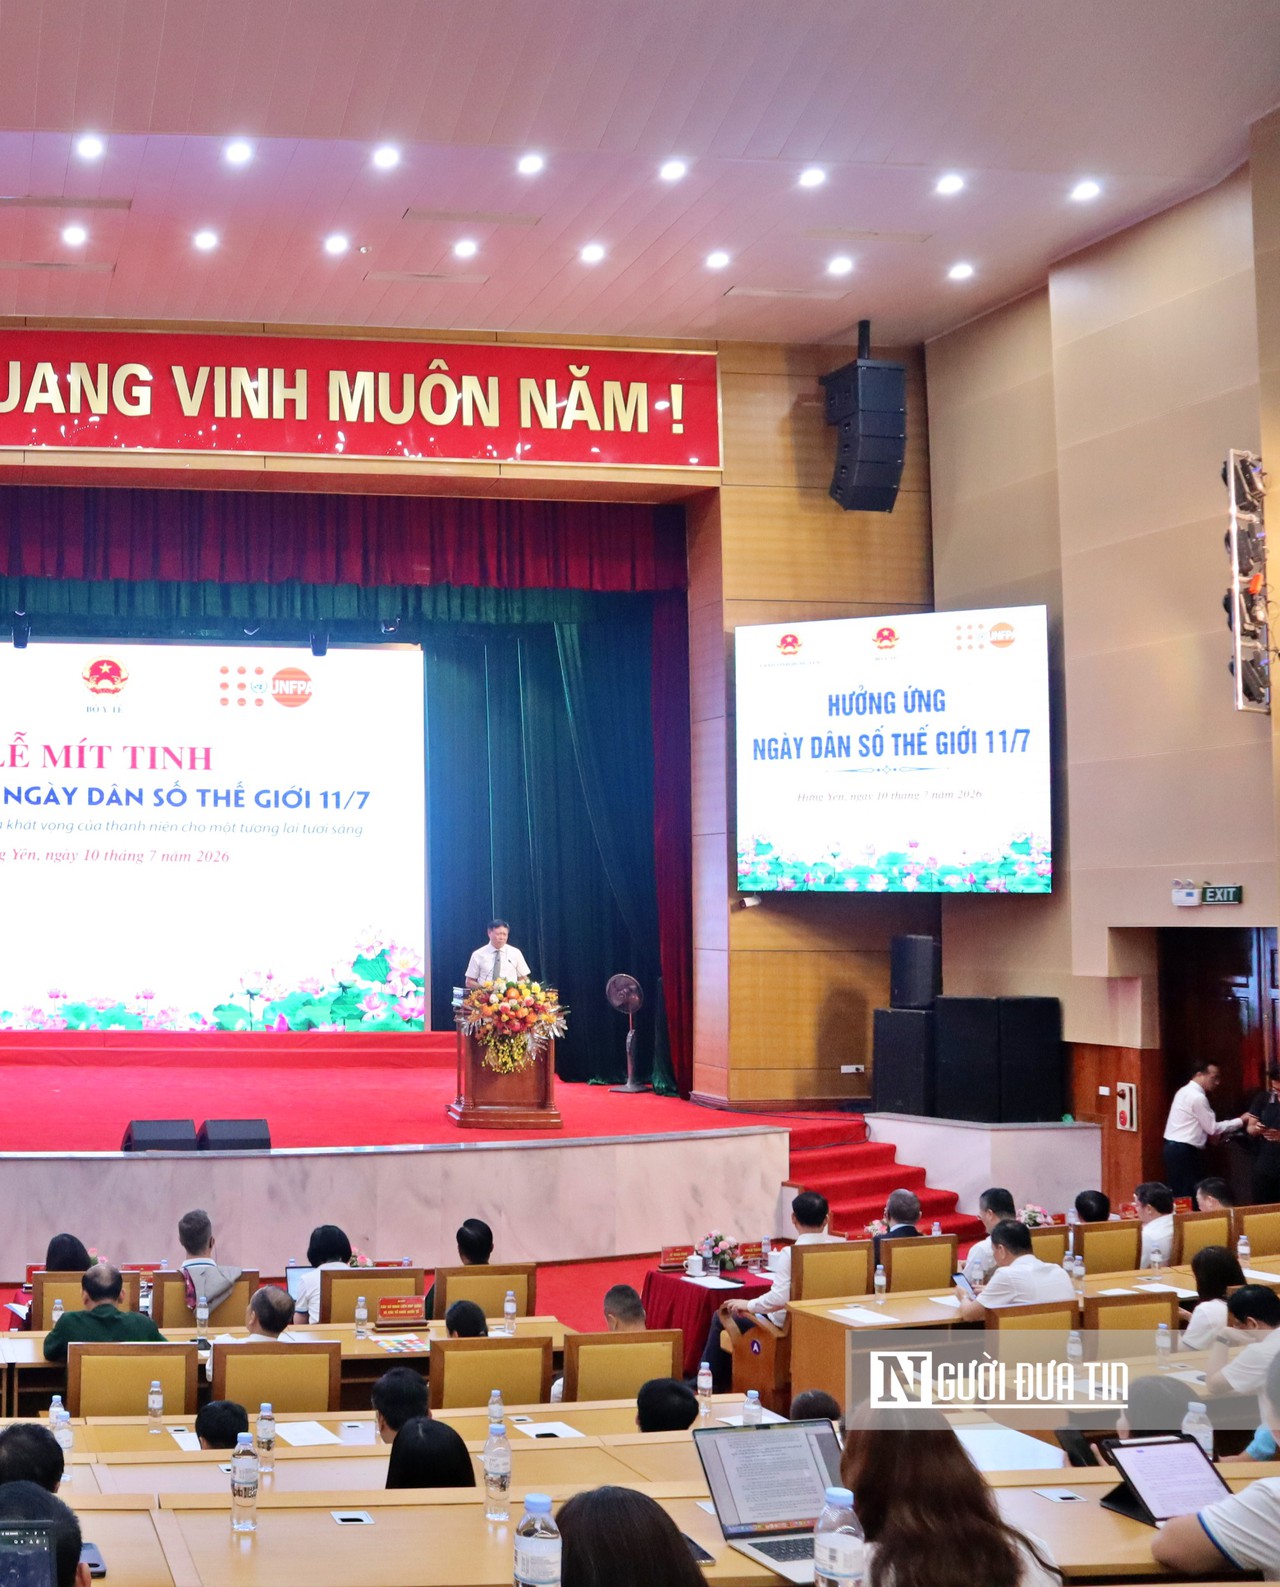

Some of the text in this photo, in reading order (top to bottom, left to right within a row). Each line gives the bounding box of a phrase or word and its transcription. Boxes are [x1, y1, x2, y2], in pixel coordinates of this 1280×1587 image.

[171, 365, 308, 420] VINH
[328, 358, 500, 427] MUÔN
[519, 365, 649, 433] NĂM
[271, 680, 313, 695] UNFPA
[828, 685, 945, 716] HƯỞNG ỨNG
[42, 738, 111, 768] MÍT
[123, 746, 211, 770] TINH
[753, 724, 1030, 760] NGÀY DÂN SỐ THẾ GIỚI 11/7
[4, 782, 78, 805] NGÀY
[88, 784, 143, 806] DÂN
[153, 781, 187, 807] SỐ
[196, 781, 245, 807] THẾ
[255, 786, 310, 809] GIỚI
[320, 791, 370, 809] 11/7
[6, 820, 36, 830] khát
[41, 821, 74, 833] vọng
[78, 821, 101, 831] của
[106, 821, 145, 832] thanh
[149, 821, 178, 832] niên
[182, 821, 206, 832] cho
[210, 822, 235, 833] một
[240, 823, 279, 836] tương
[283, 823, 298, 833] lai
[303, 824, 328, 834] tươi
[332, 824, 363, 837] sáng
[13, 848, 40, 861] Yên,
[46, 849, 78, 863] ngày
[84, 850, 99, 861] 10
[104, 850, 143, 864] tháng
[150, 850, 156, 861] 7
[161, 850, 191, 862] năm
[197, 850, 229, 862] 2026
[1206, 888, 1236, 902] EXIT
